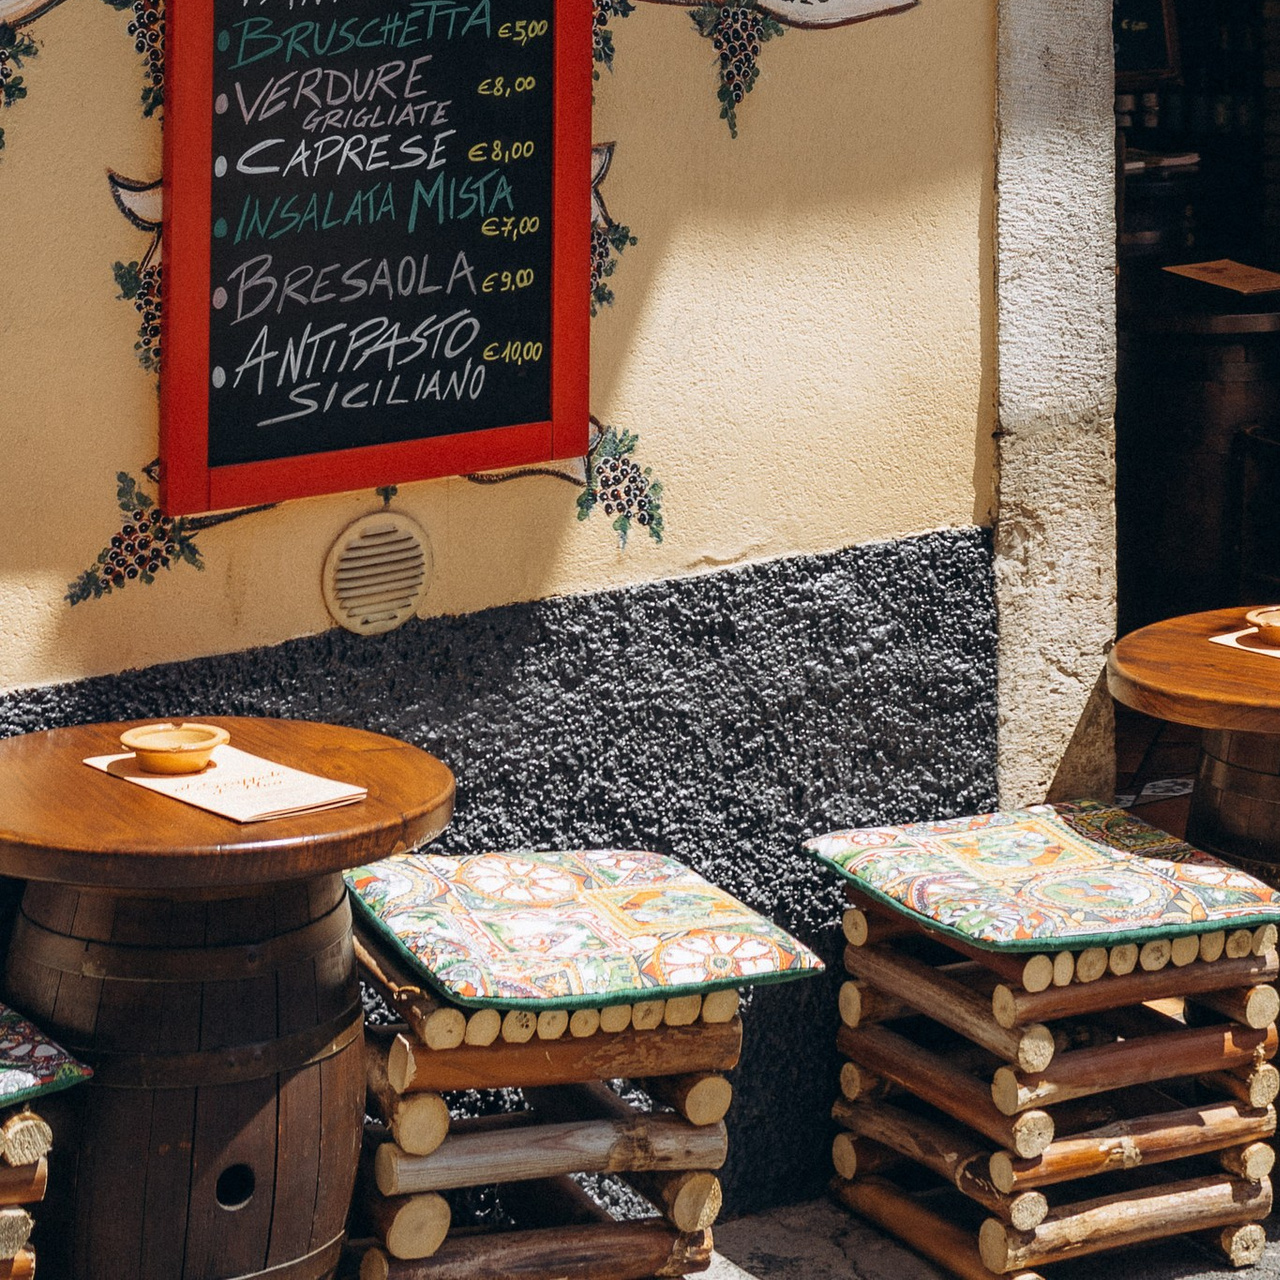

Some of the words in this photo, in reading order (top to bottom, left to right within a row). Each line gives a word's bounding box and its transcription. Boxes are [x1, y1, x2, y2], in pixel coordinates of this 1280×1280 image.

[498, 20, 549, 46] €5,00
[234, 54, 433, 125] VERDURE
[477, 76, 536, 97] €8,00
[302, 100, 452, 133] GRIGLIATE
[236, 129, 457, 177] CAPRESE
[468, 140, 535, 163] €8,00
[233, 182, 396, 245] INSALATA
[407, 168, 514, 234] MISTA
[481, 216, 540, 242] €7,00
[227, 250, 478, 326] BRESAOLA
[482, 269, 534, 292] €9,00
[232, 309, 481, 395] ANTIPASTO
[483, 341, 543, 366] €10,00
[257, 357, 486, 427] SICILIANO
